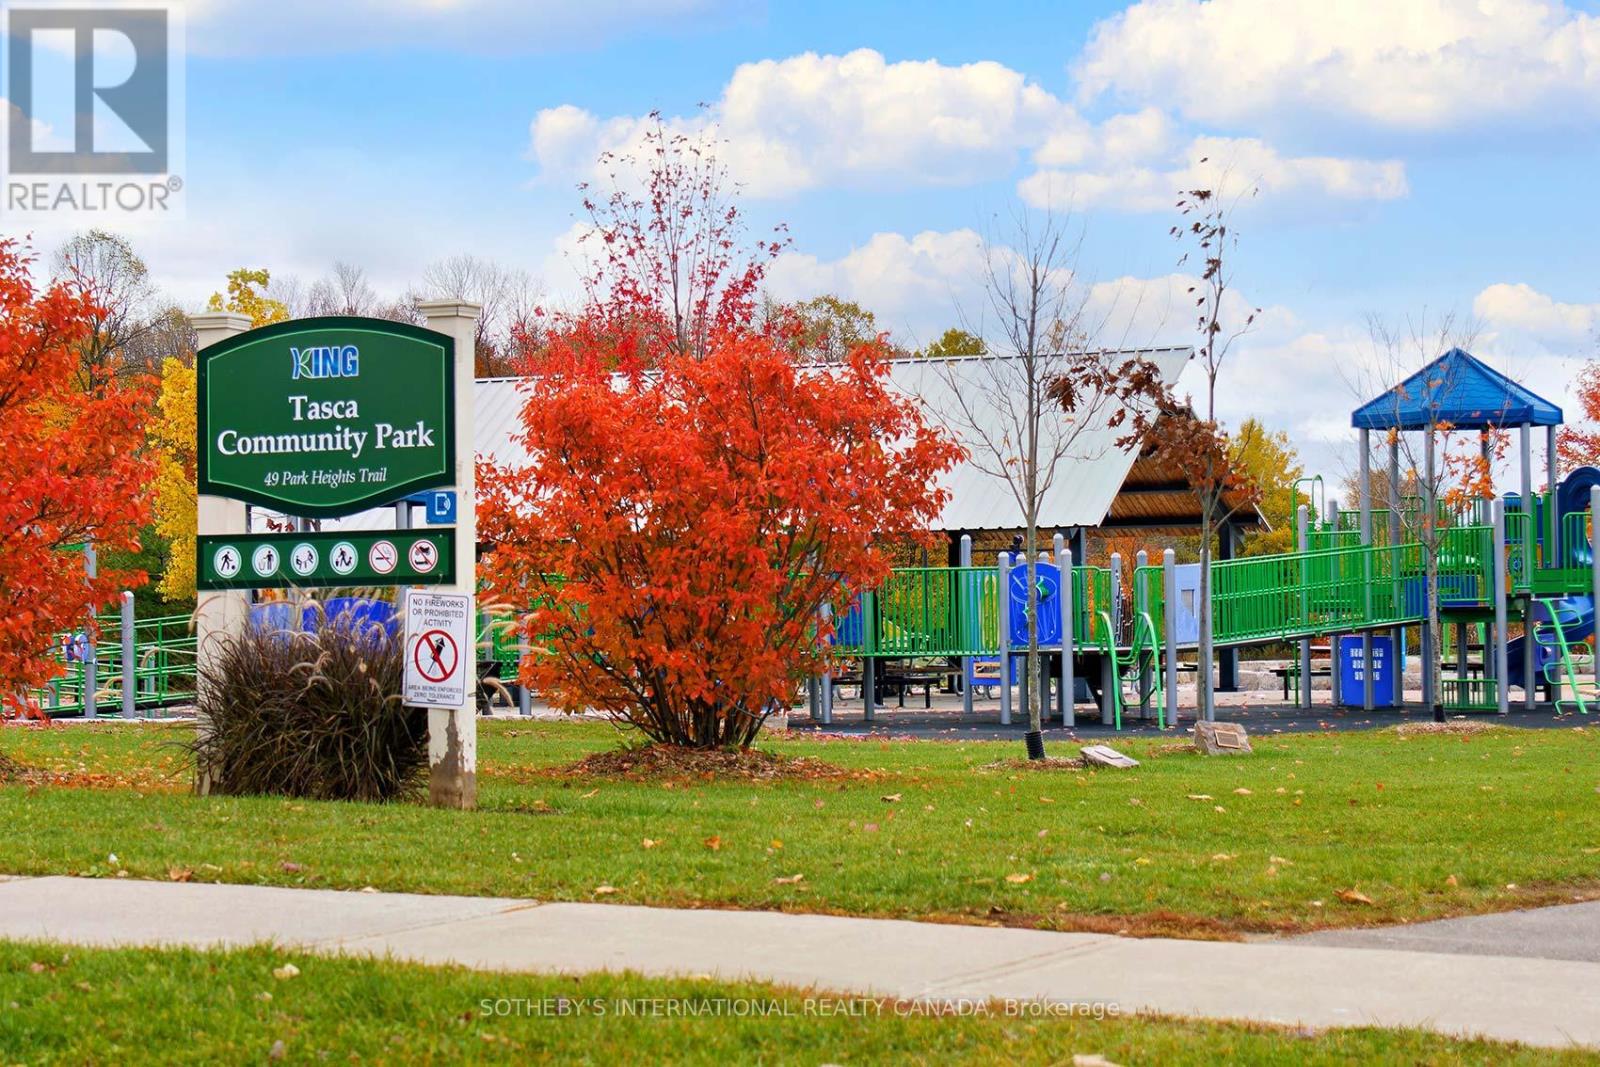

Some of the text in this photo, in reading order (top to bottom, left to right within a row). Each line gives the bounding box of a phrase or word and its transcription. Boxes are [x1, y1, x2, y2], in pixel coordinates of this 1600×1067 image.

[290, 345, 359, 380] KING
[289, 396, 359, 421] Tasca
[217, 421, 435, 458] Community Park
[264, 467, 387, 488] 49 Park Heights Trail
[412, 598, 464, 608] NO FIREWORKS
[412, 608, 464, 618] OR PROHIBITED
[424, 619, 453, 627] ACTIVITY
